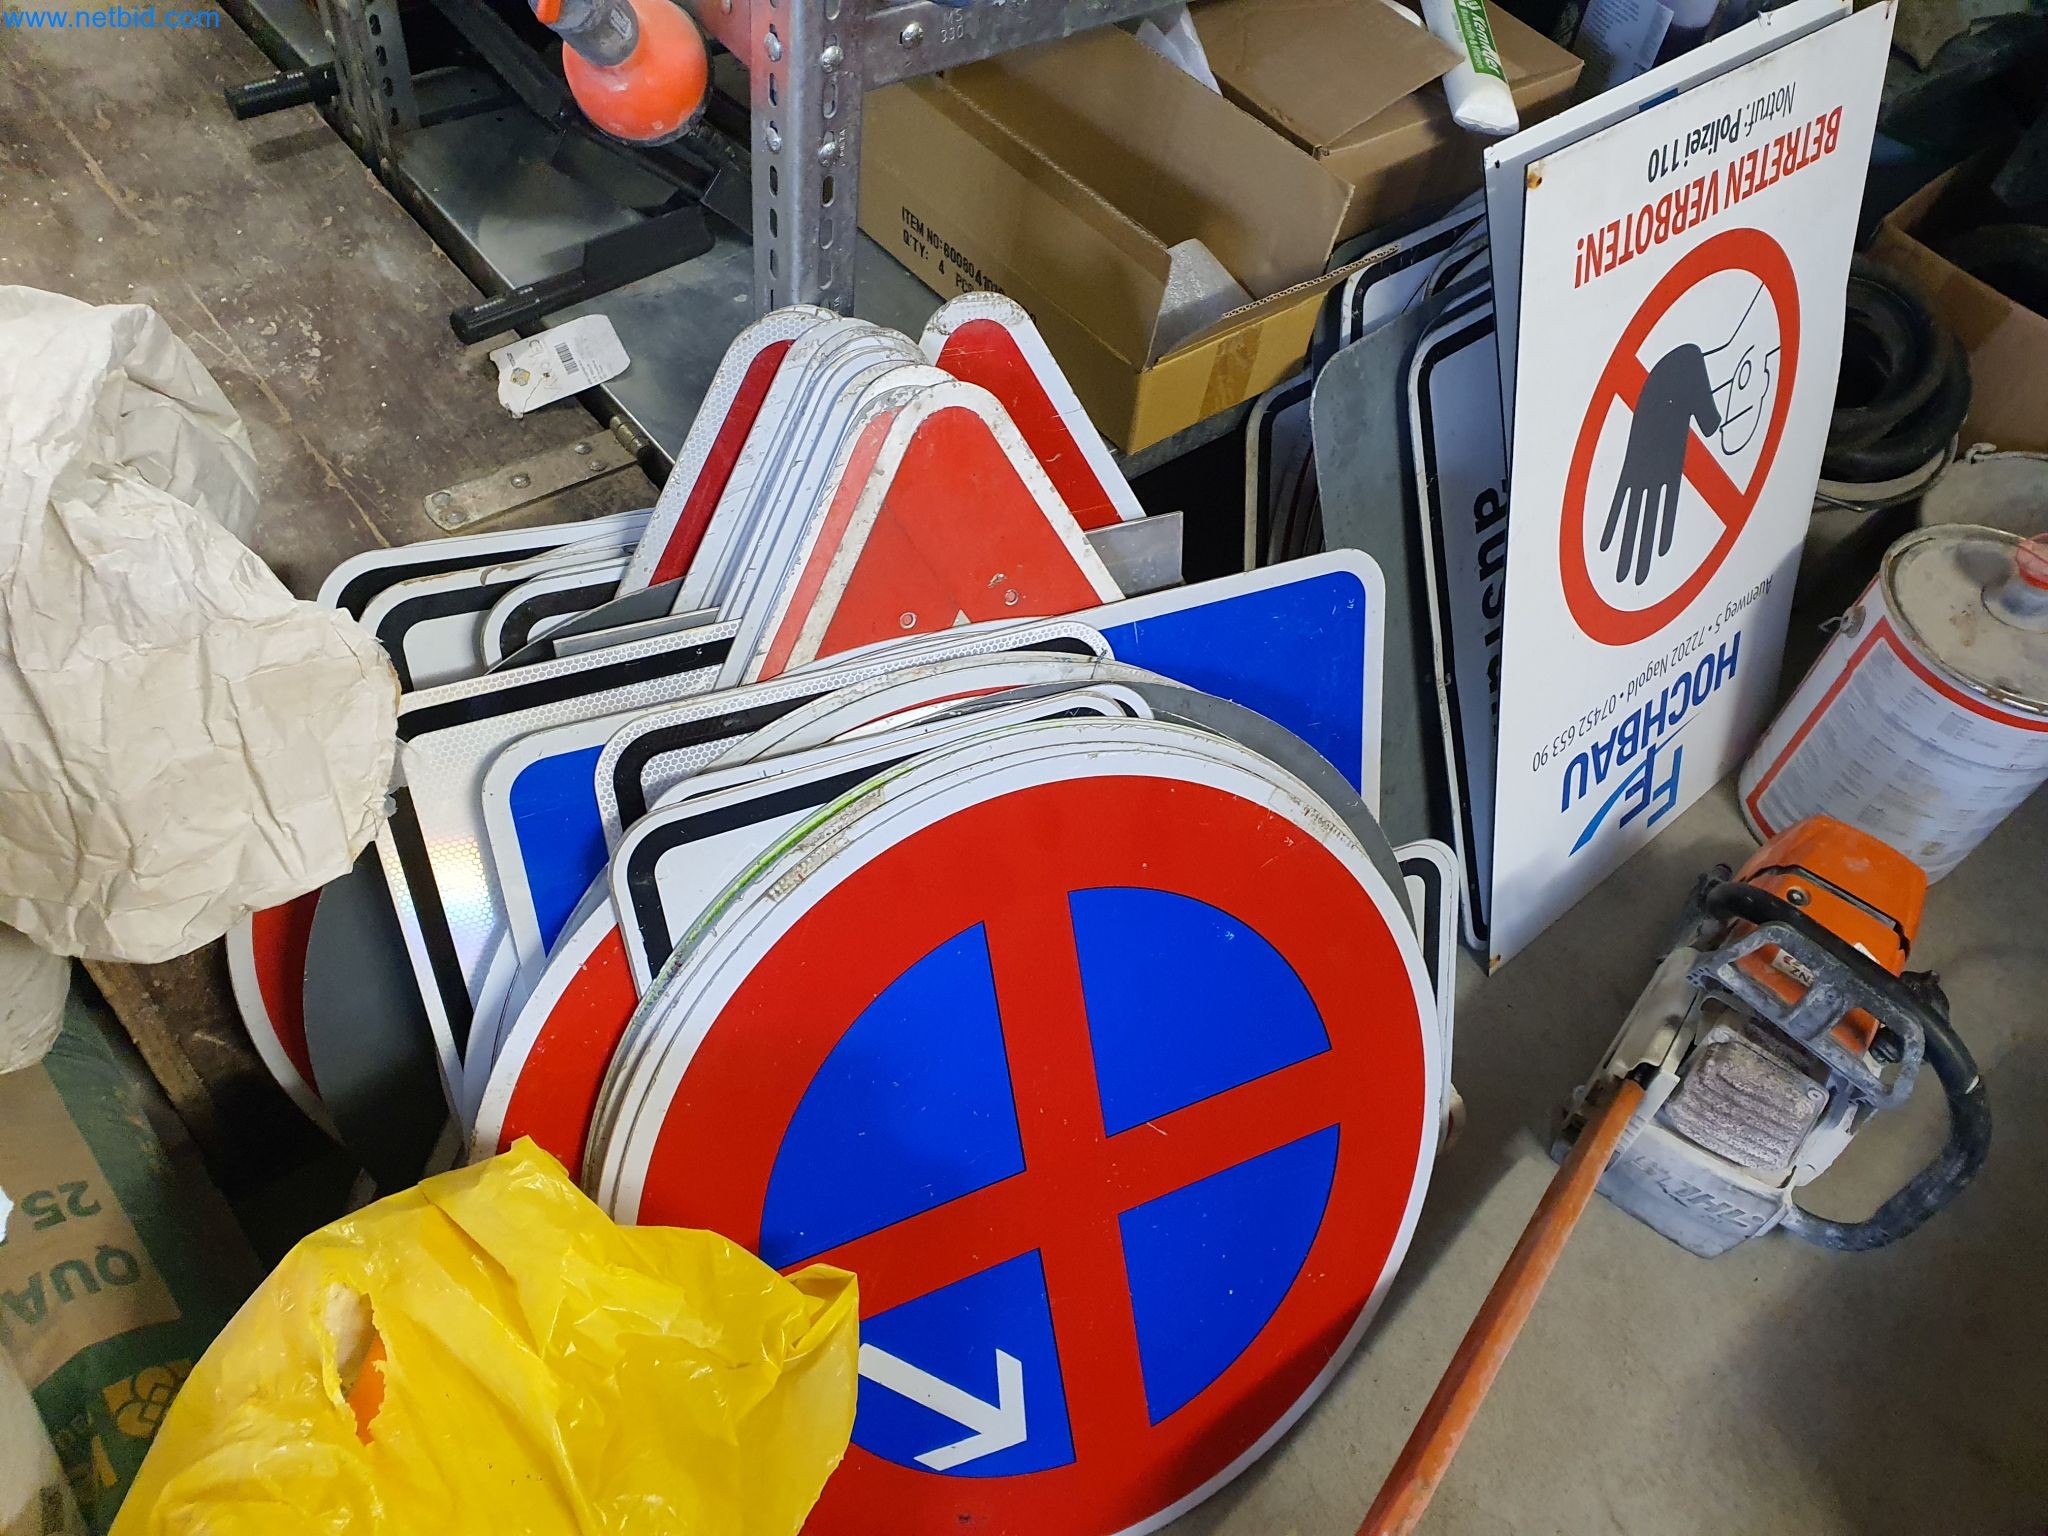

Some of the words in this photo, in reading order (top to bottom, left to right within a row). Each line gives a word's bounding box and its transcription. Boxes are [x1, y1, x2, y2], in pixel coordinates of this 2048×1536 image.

[1744, 81, 1796, 137] Notruf:
[1647, 137, 1680, 183] 110
[1684, 108, 1742, 167] Polizei
[1723, 105, 1843, 210] BETRETEN
[902, 205, 924, 237] ITEM
[1574, 169, 1720, 289] VERBOTEN!
[938, 259, 945, 275] 4
[1724, 574, 1773, 622] Auenweg
[1671, 625, 1706, 668] 72202
[1714, 613, 1723, 634] 5
[1626, 654, 1669, 702] Nagold
[1561, 630, 1742, 814] HOCHBAU
[1578, 692, 1616, 738] 07452
[1532, 744, 1549, 772] 90
[1552, 724, 1576, 759] 653
[21, 1180, 102, 1231] 25
